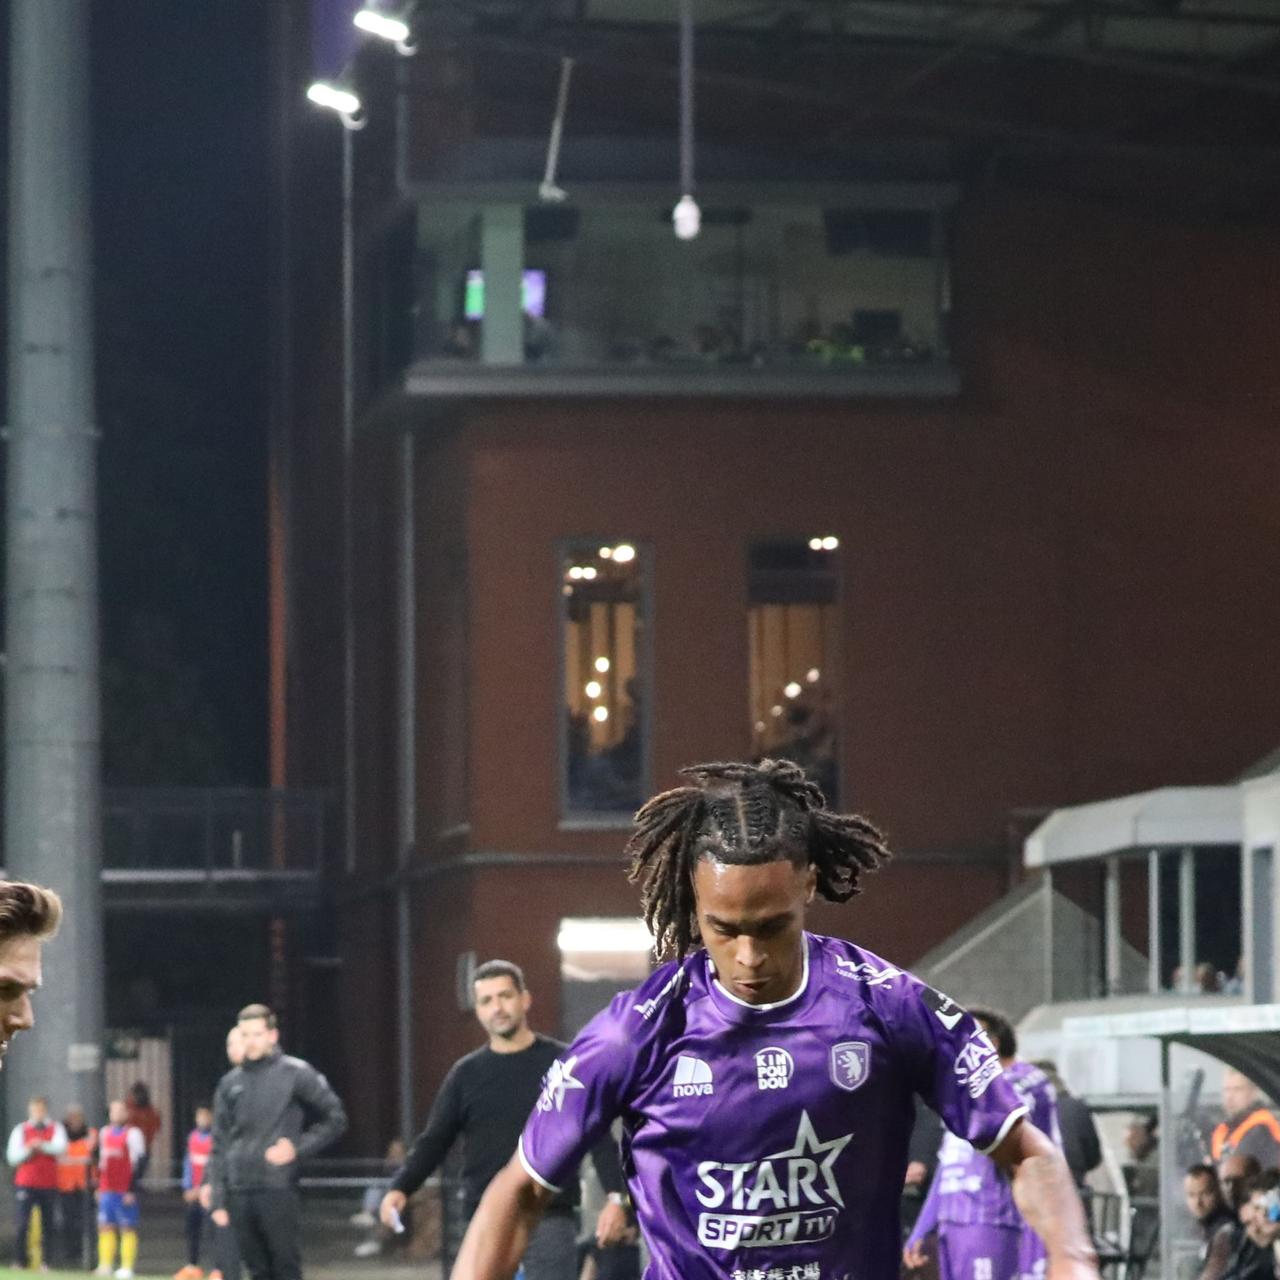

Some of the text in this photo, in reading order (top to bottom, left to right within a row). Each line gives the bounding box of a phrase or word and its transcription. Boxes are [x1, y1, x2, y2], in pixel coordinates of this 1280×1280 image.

[757, 1066, 787, 1078] POU
[673, 1083, 714, 1098] nova
[758, 1077, 788, 1090] DOU
[695, 1157, 826, 1212] STAR
[704, 1215, 834, 1242] SPORT TV
